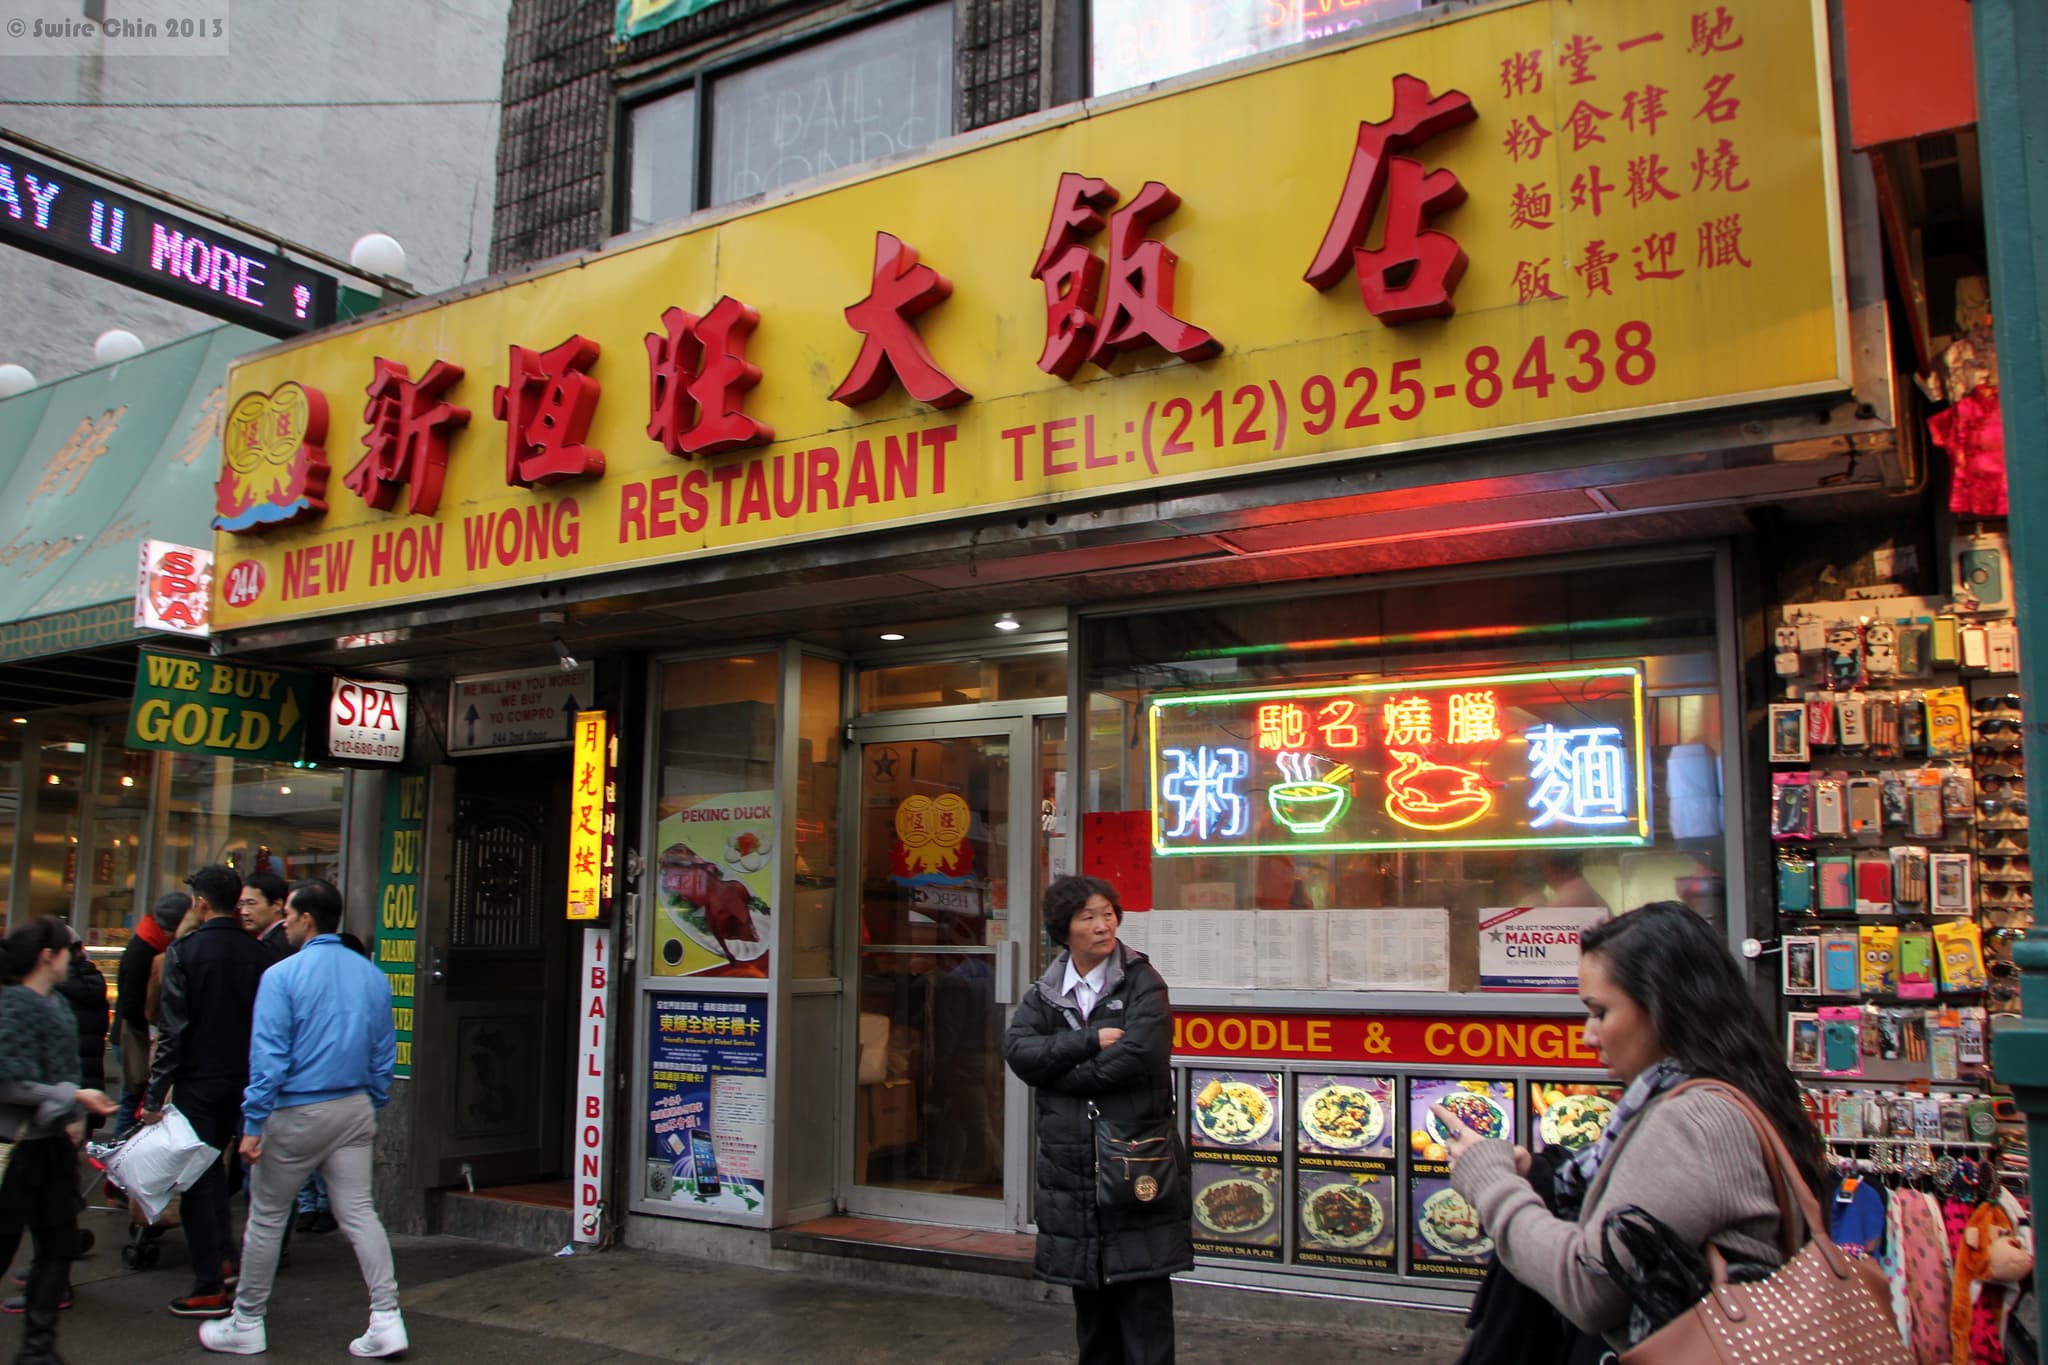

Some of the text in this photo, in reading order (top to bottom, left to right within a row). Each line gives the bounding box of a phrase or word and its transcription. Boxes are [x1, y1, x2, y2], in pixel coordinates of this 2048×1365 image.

[1617, 32, 1685, 281] 一律歡迎
[1686, 6, 1752, 269] 馳名燒臘
[1500, 49, 1568, 305] 粥粉麵飯
[1559, 34, 1619, 298] 堂食外賣
[90, 200, 125, 254] U
[152, 222, 266, 307] MORE
[228, 563, 260, 604] 244
[281, 540, 354, 602] NEW
[370, 522, 443, 588] HON
[463, 497, 580, 572] WONG
[619, 425, 958, 545] RESTAURANT
[158, 551, 198, 627] SPA
[146, 655, 281, 701] WE BUY
[463, 684, 478, 697] WE
[480, 681, 502, 695] WILL
[505, 679, 522, 693] PAY
[526, 676, 547, 690] YOU
[500, 691, 543, 707] WE BUY
[136, 699, 271, 751] GOLD
[337, 684, 401, 731] SPA
[489, 707, 555, 725] YO COMPRO
[1259, 690, 1502, 750] 馳名燒臘
[400, 776, 425, 820] WE
[1162, 745, 1248, 840] 粥
[1526, 722, 1630, 828] 麵
[681, 805, 772, 823] PEKING DUCK
[1506, 946, 1547, 959] CHIN
[587, 966, 607, 1078] BAIL
[1364, 1022, 1392, 1054] &
[1193, 1152, 1222, 1160] CHICKEN
[1232, 1154, 1266, 1163] BROCCOLI
[1299, 1158, 1325, 1166] CHICKEN
[1413, 1164, 1432, 1173] BEEF
[1216, 1245, 1234, 1253] PORK
[1252, 1249, 1275, 1258] PLATE
[1413, 1263, 1445, 1273] SEAFOOD
